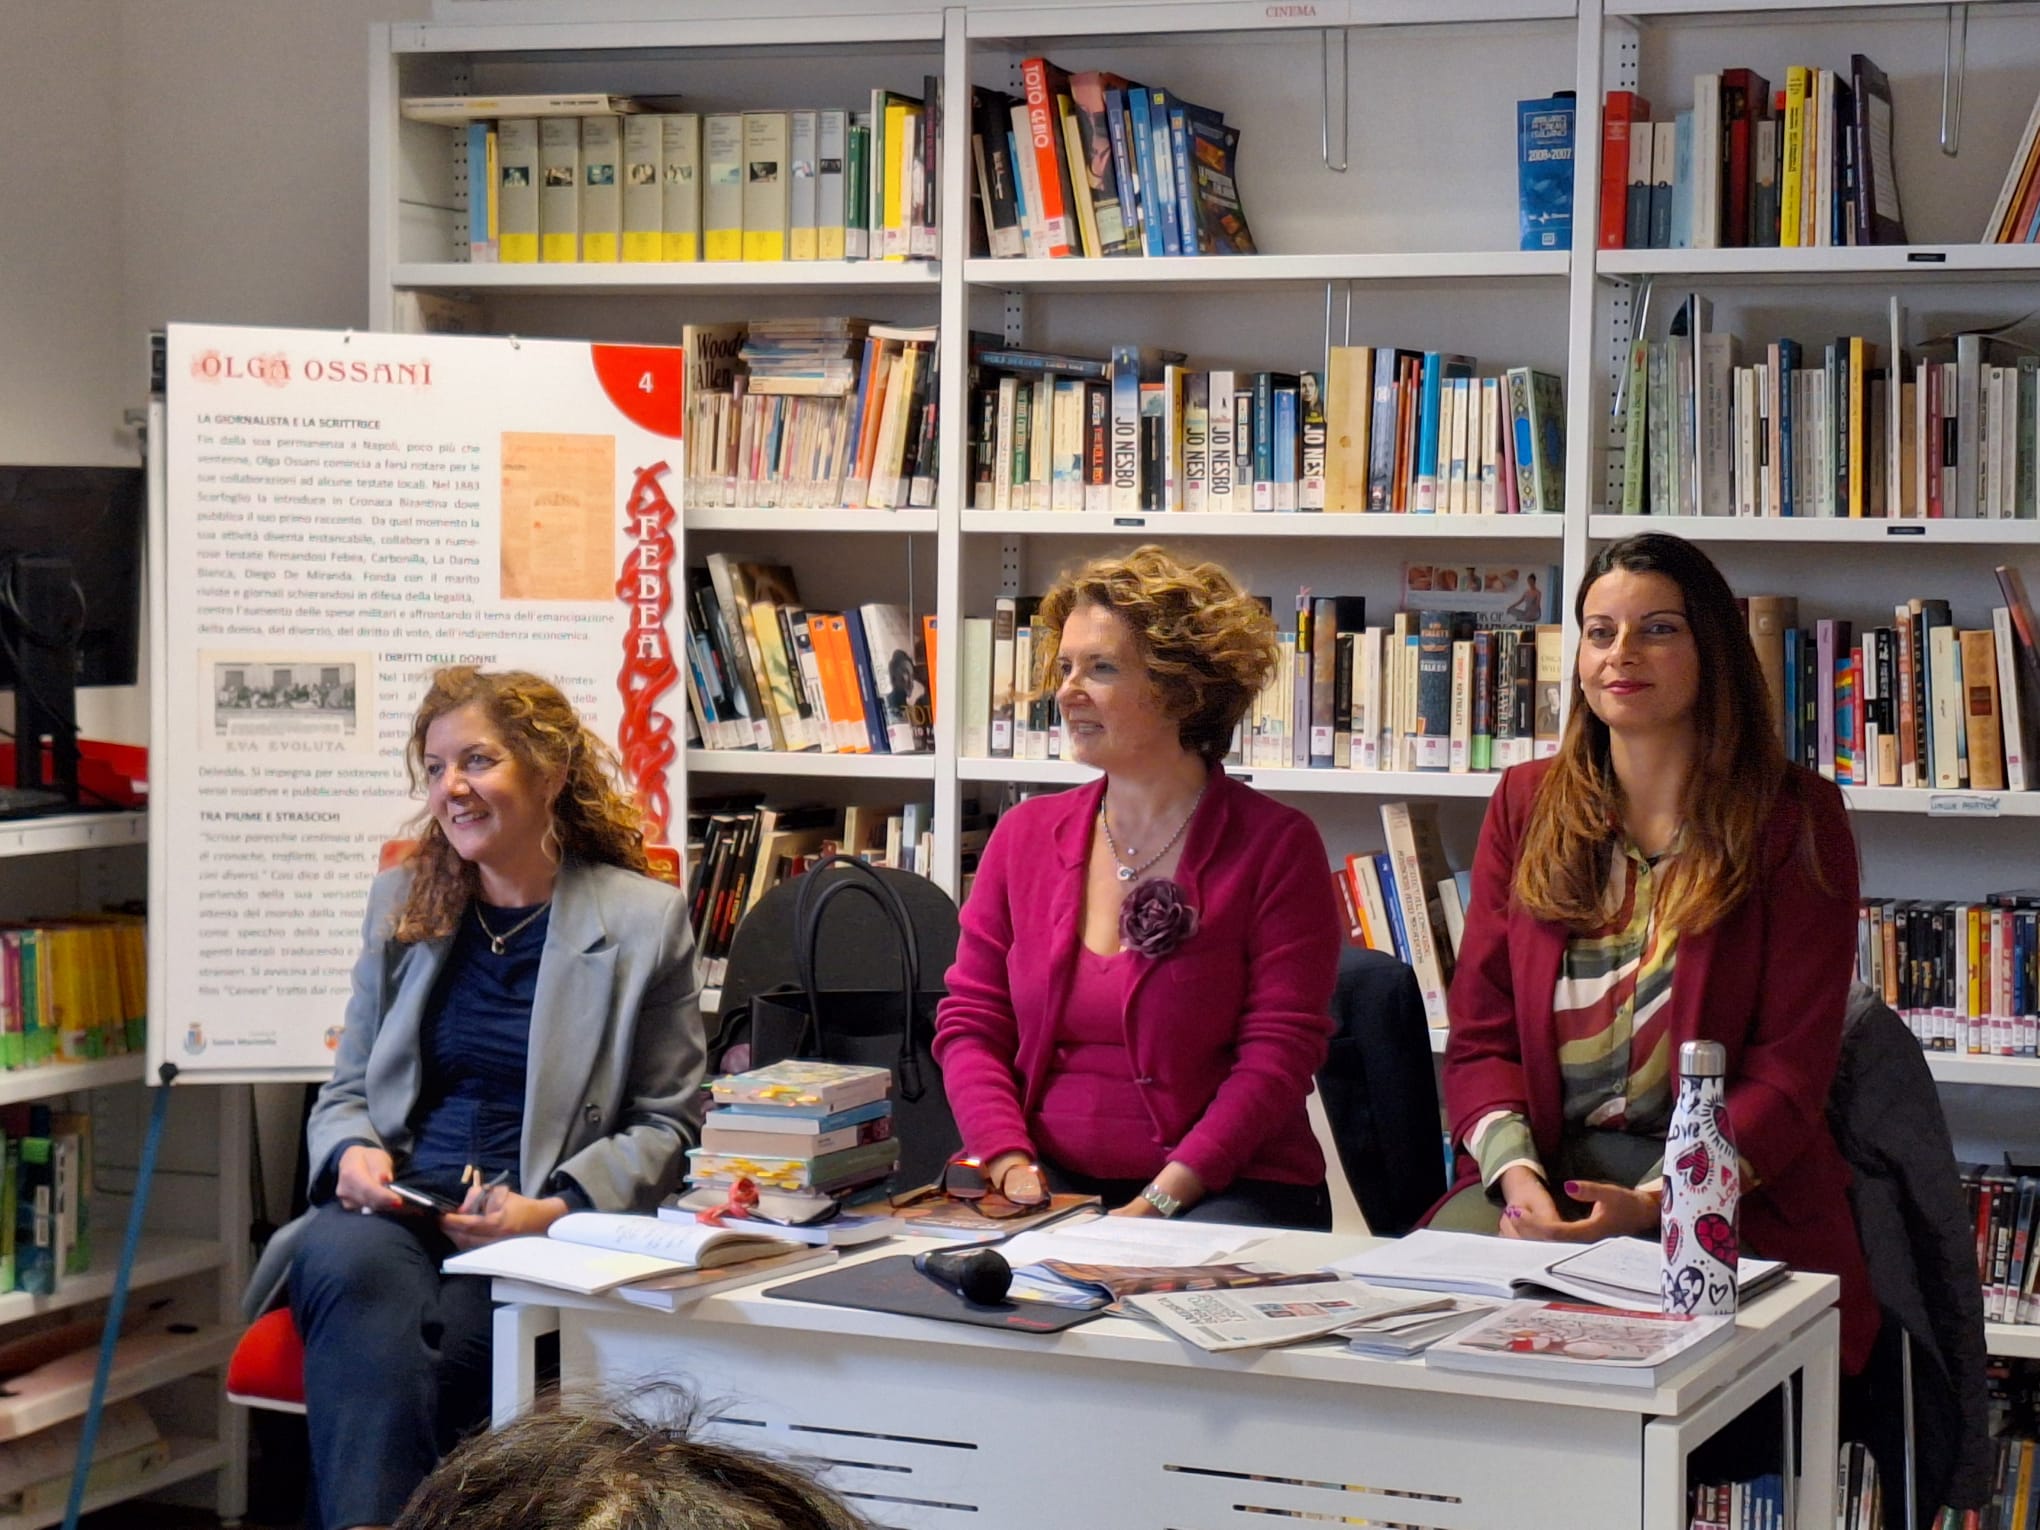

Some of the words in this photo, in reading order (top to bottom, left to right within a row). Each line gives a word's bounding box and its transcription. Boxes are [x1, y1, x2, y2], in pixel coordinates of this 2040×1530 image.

[1265, 5, 1317, 17] CINEMA
[697, 331, 744, 361] Wood
[202, 356, 290, 380] OLGA
[304, 360, 432, 385] OSSANI
[638, 372, 653, 393] 4
[197, 415, 211, 423] LA
[215, 415, 289, 425] GIORNALISTA
[293, 417, 298, 427] E
[302, 418, 315, 427] LA
[319, 419, 380, 429] SCRITTRICE
[1115, 417, 1135, 436] JO
[1187, 428, 1204, 445] JO
[1212, 427, 1230, 445] JO
[1304, 424, 1323, 445] JO
[407, 444, 433, 454] poco
[461, 445, 480, 453] che
[256, 456, 280, 467] Olga
[284, 456, 320, 466] Ossani
[433, 555, 445, 564] La
[449, 555, 480, 565] Dama
[245, 569, 276, 581] Diego
[284, 570, 299, 580] De
[363, 572, 396, 582] Fonda
[445, 575, 480, 584] marito
[636, 516, 662, 659] FEBEA
[426, 654, 455, 664] DELLE
[458, 655, 496, 663] DONNE
[226, 741, 259, 752] EVA
[268, 741, 346, 752] EVOLUTA
[200, 812, 222, 821] TRA
[225, 812, 262, 821] PIUME
[266, 812, 272, 821] E
[276, 812, 340, 822] STRASCICHI
